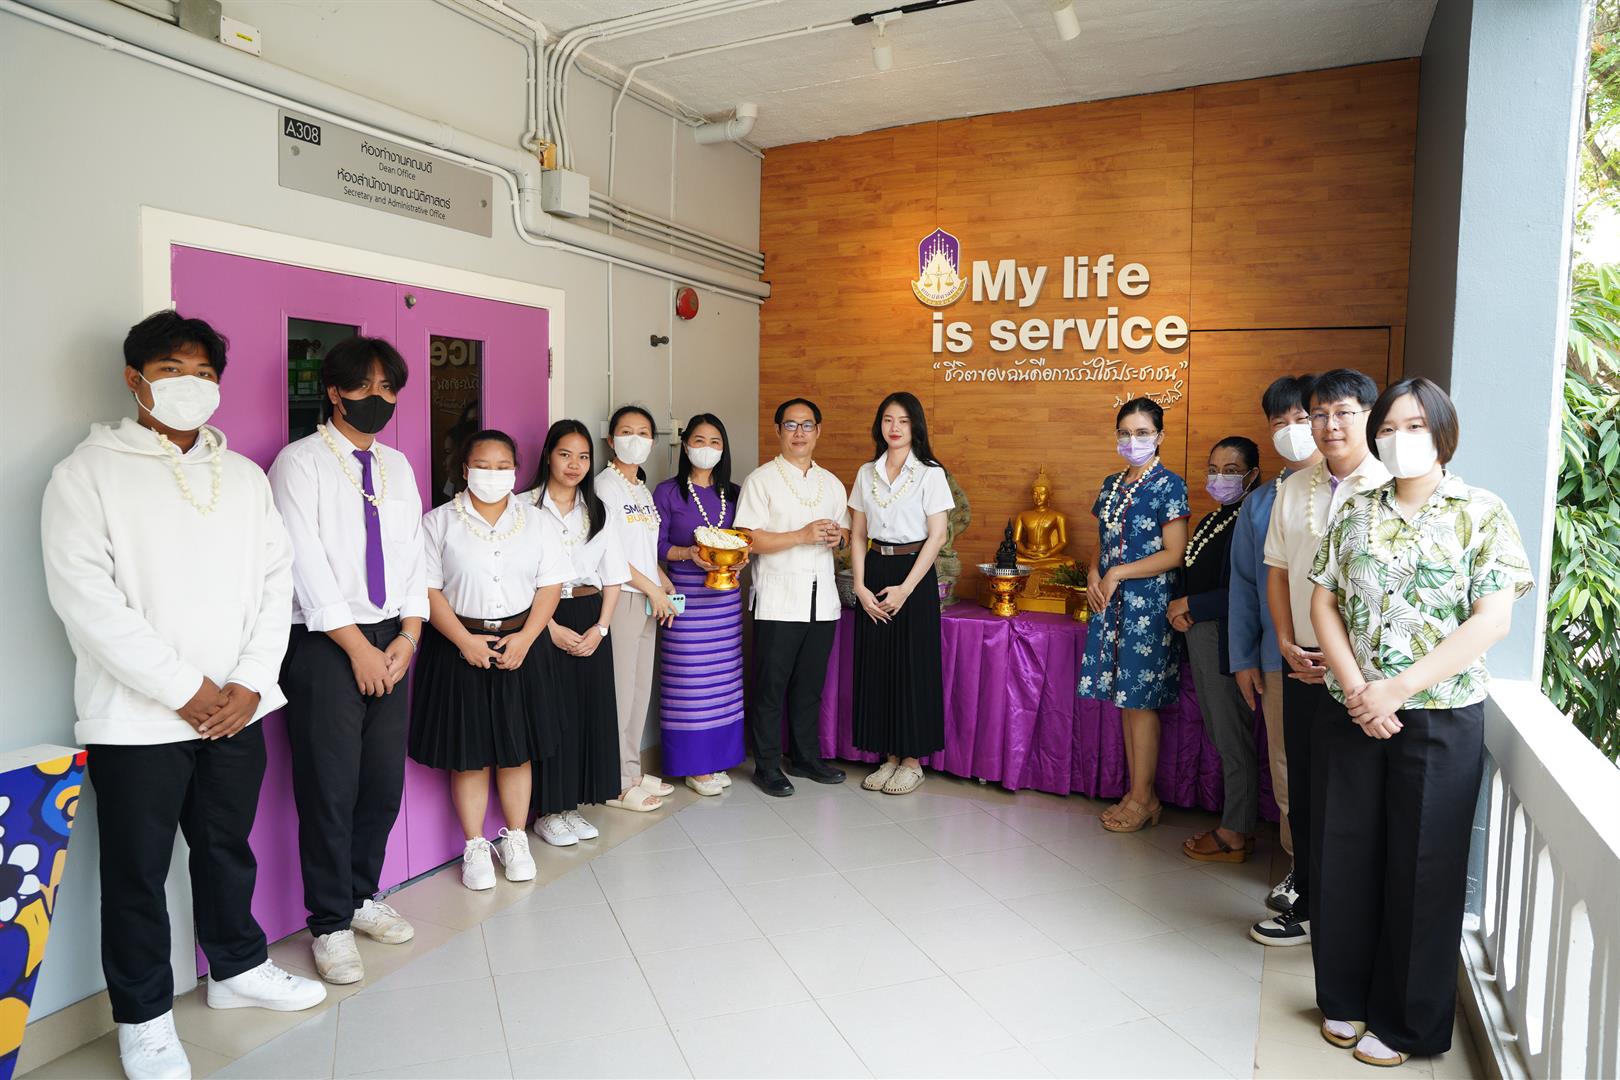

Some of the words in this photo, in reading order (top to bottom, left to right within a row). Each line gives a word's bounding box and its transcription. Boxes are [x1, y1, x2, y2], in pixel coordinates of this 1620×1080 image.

[285, 119, 319, 143] A308
[361, 141, 432, 174] ห้องทำงานคณบดี
[378, 162, 396, 174] Dean
[397, 167, 416, 180] Office
[337, 168, 451, 210] ห้องสำนักงานคณะนิติศาสตร์
[343, 186, 373, 203] Secretary
[374, 195, 387, 205] and
[387, 198, 429, 216] Administrative
[429, 208, 446, 220] Office
[972, 258, 1048, 308] My
[1063, 254, 1150, 298] life
[932, 311, 973, 353] is
[989, 306, 1188, 351] service
